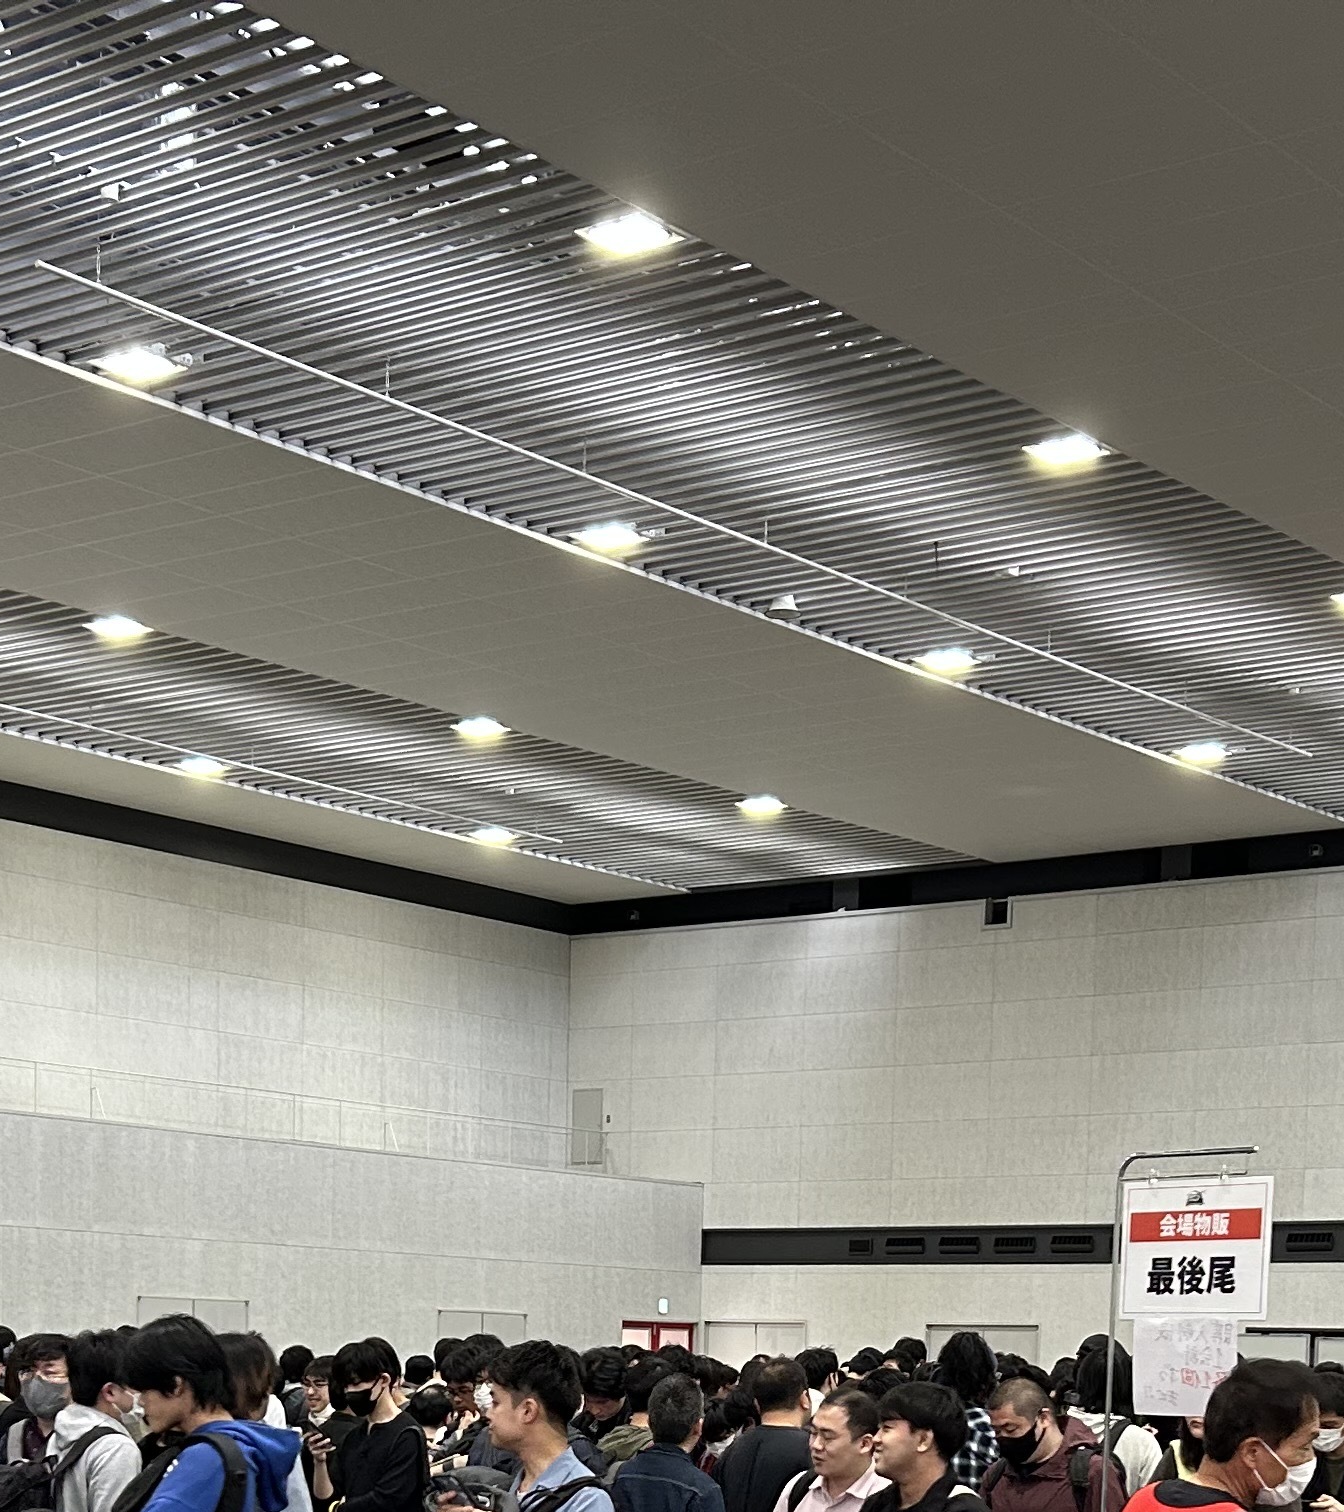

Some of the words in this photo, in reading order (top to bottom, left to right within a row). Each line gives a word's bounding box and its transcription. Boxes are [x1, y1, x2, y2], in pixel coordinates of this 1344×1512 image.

[1159, 1213, 1230, 1237] 会場物販
[1147, 1256, 1236, 1295] 最後尾
